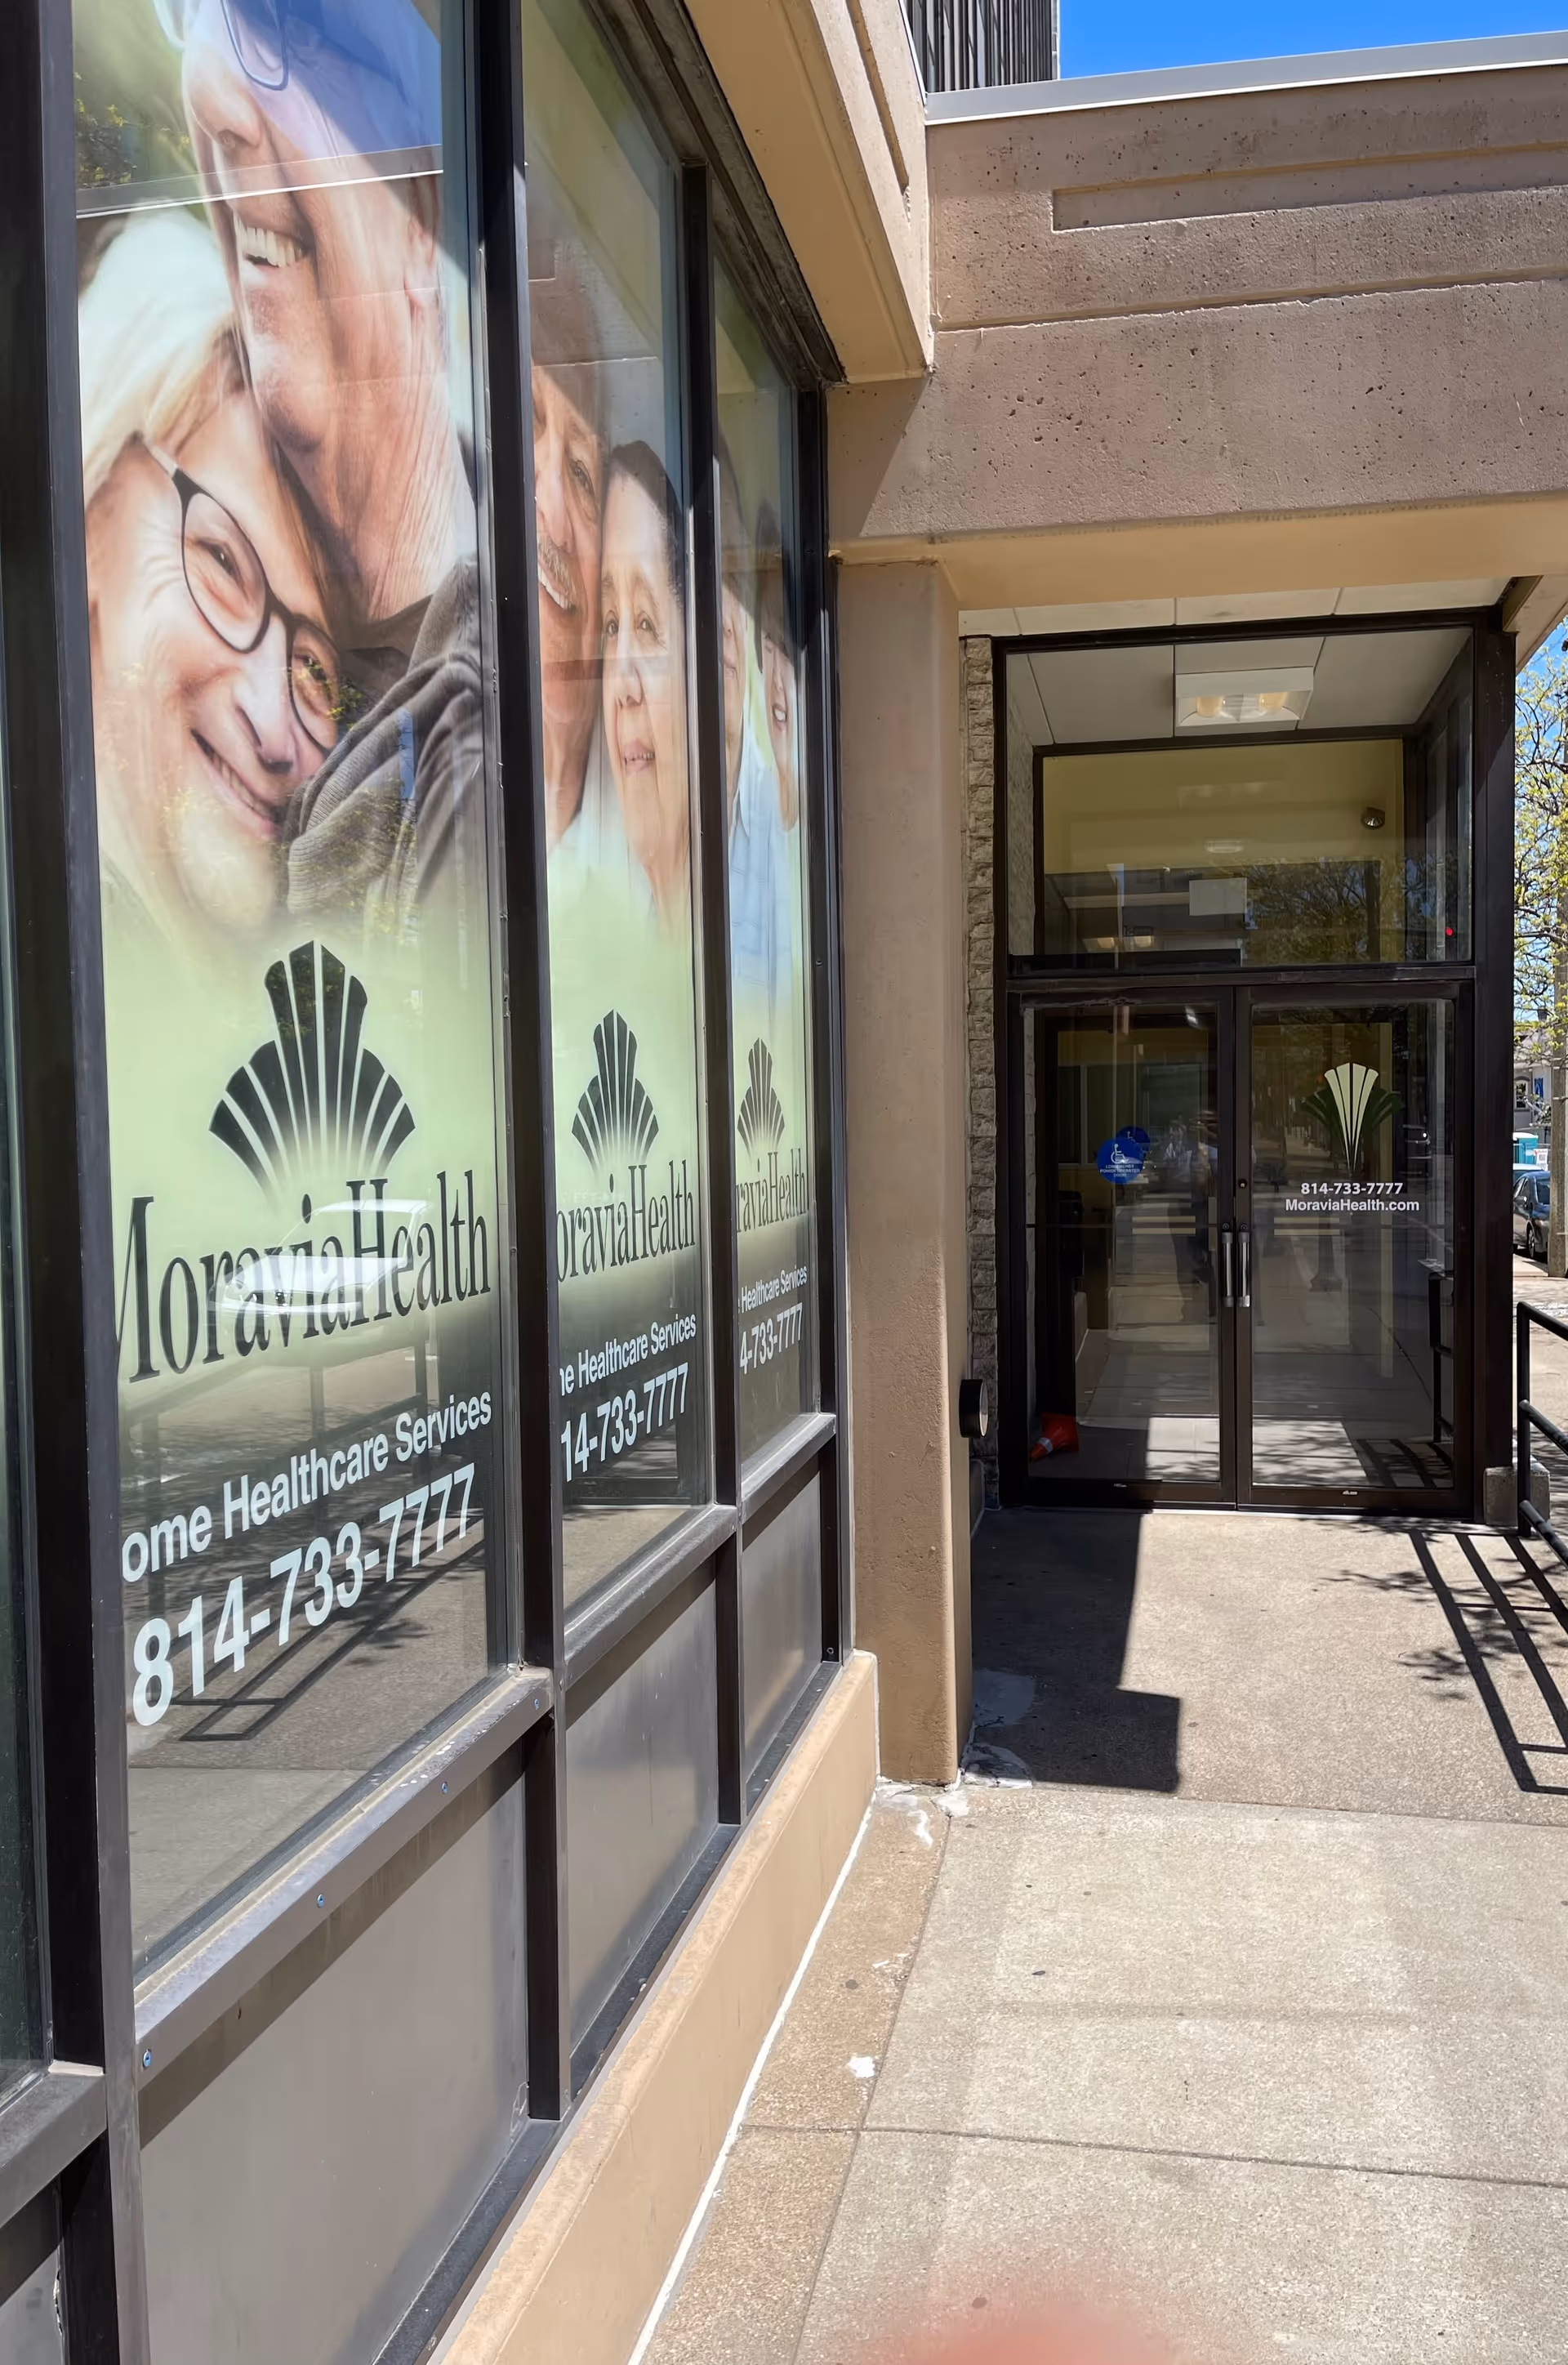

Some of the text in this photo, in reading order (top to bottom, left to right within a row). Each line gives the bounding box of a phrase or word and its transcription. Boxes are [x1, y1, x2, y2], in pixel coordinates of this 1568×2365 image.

[556, 1159, 695, 1283] oraviaHealth
[735, 1148, 807, 1233] raviaHealth
[1285, 1198, 1419, 1212] MoraviaHealth.com
[1300, 1182, 1403, 1195] 814-733-7777
[742, 1278, 780, 1314] Healthcare
[781, 1265, 807, 1295] Services
[578, 1333, 648, 1388] Healthcare
[651, 1314, 696, 1355] Services
[740, 1302, 803, 1375] 4-733-7777
[561, 1362, 688, 1483] 14-733-7777
[122, 1391, 492, 1582] ome Healthcare Services
[132, 1462, 476, 1726] 814-733-7777
